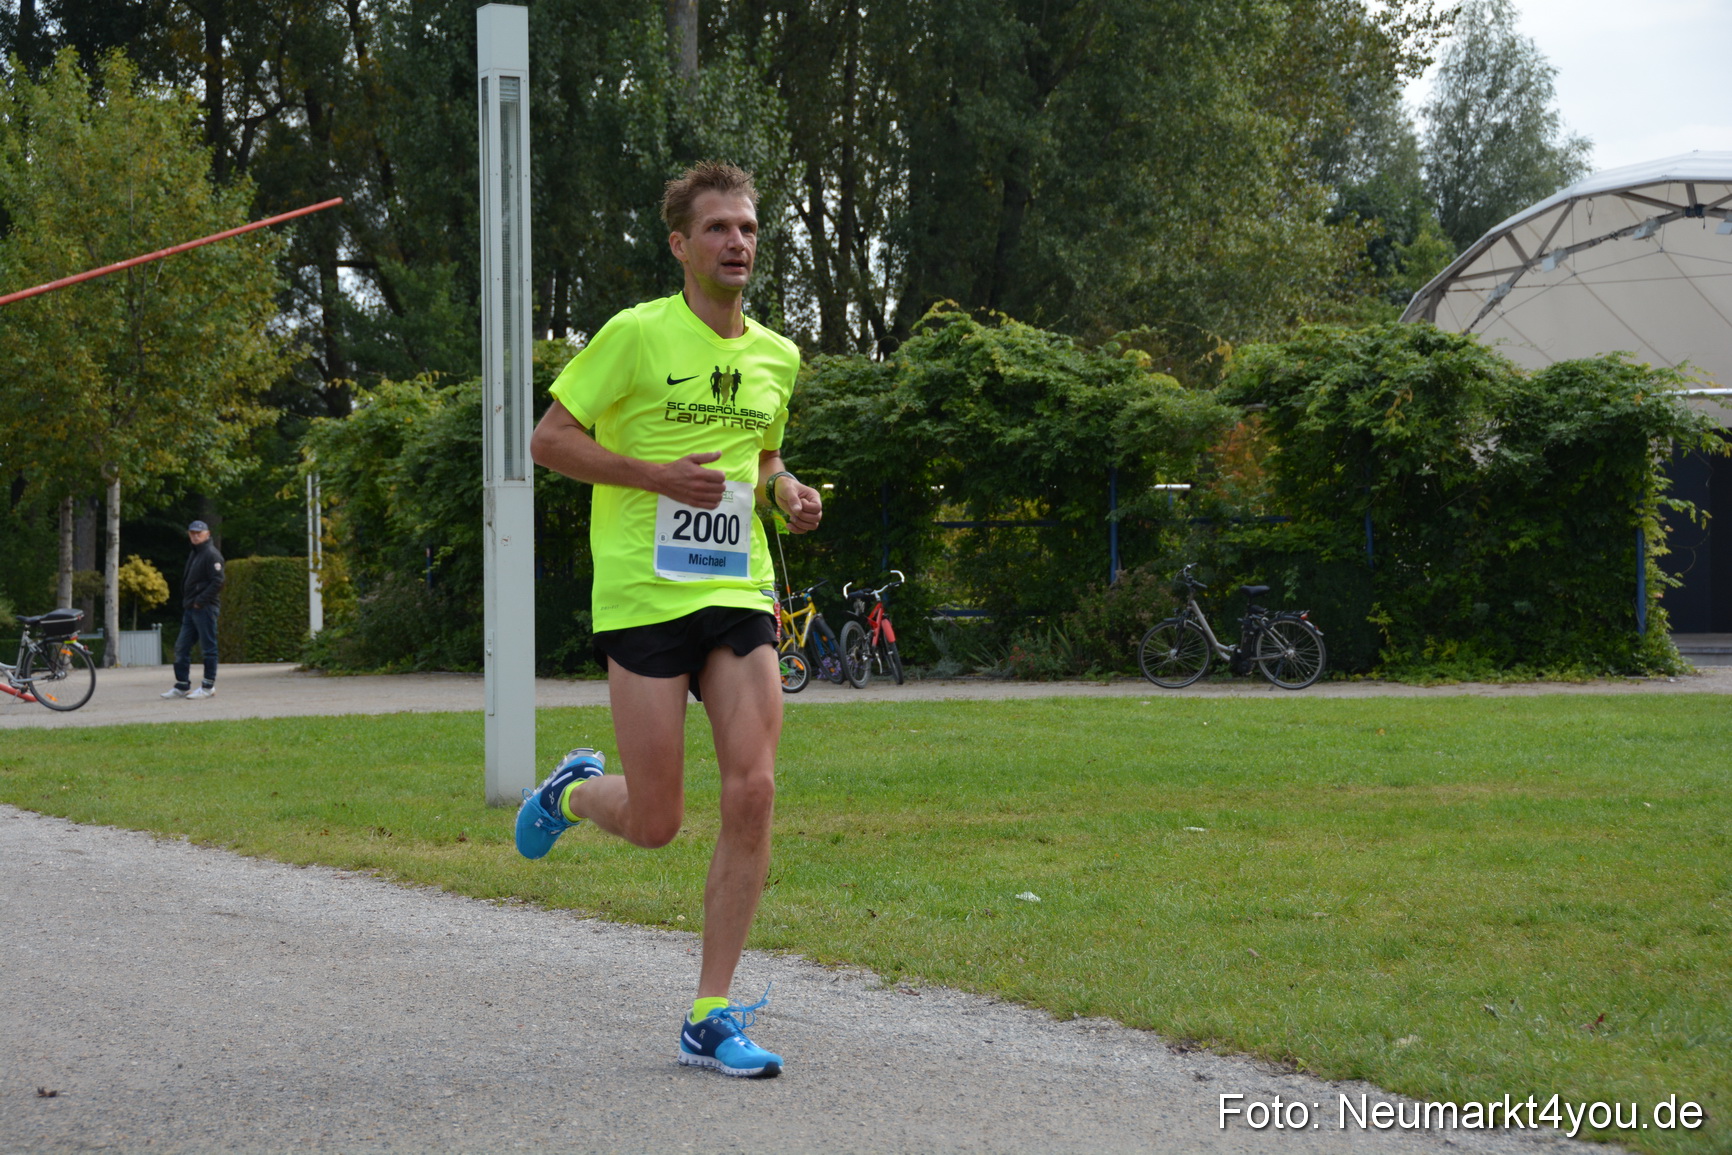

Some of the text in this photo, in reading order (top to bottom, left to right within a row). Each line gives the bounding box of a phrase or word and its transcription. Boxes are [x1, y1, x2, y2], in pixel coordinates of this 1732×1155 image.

[666, 401, 686, 411] SC
[672, 509, 740, 546] 2000
[688, 553, 727, 568] Michael
